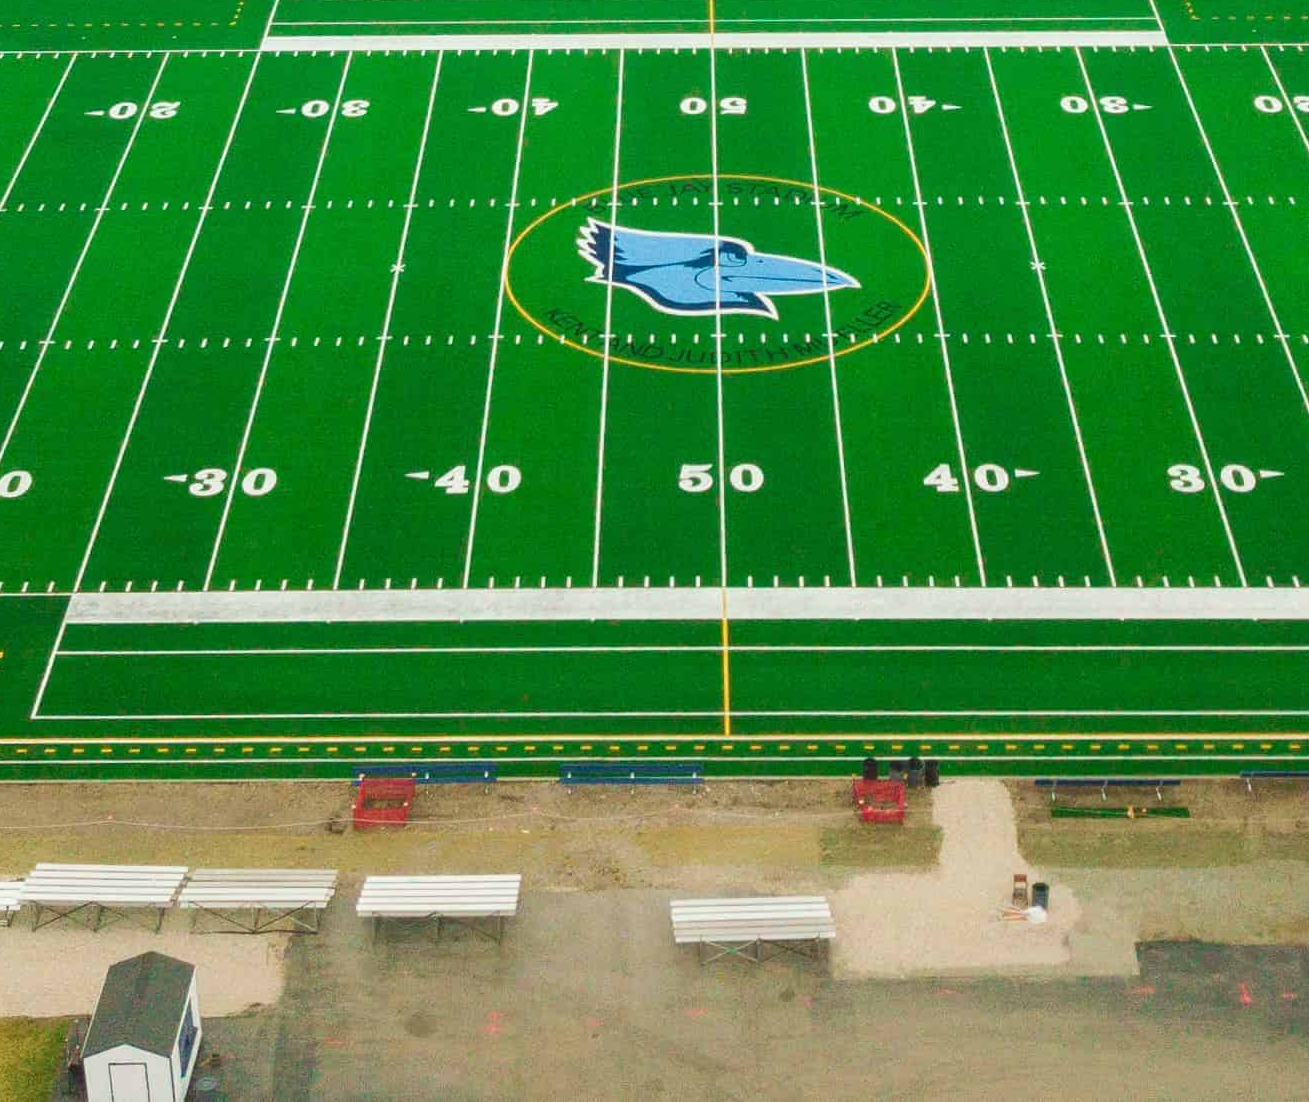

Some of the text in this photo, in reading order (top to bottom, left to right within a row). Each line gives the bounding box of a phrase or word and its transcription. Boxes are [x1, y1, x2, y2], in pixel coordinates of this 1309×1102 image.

[109, 101, 181, 119] 20
[301, 99, 370, 117] 30
[491, 98, 558, 116] 40
[680, 97, 747, 115] 50
[868, 96, 936, 114] 40
[1060, 96, 1129, 114] 30
[669, 345, 791, 364] JUDITH
[189, 468, 277, 496] 30
[435, 465, 521, 494] 40
[679, 464, 764, 492] 50
[923, 464, 1009, 492] 40
[1167, 464, 1256, 493] 30
